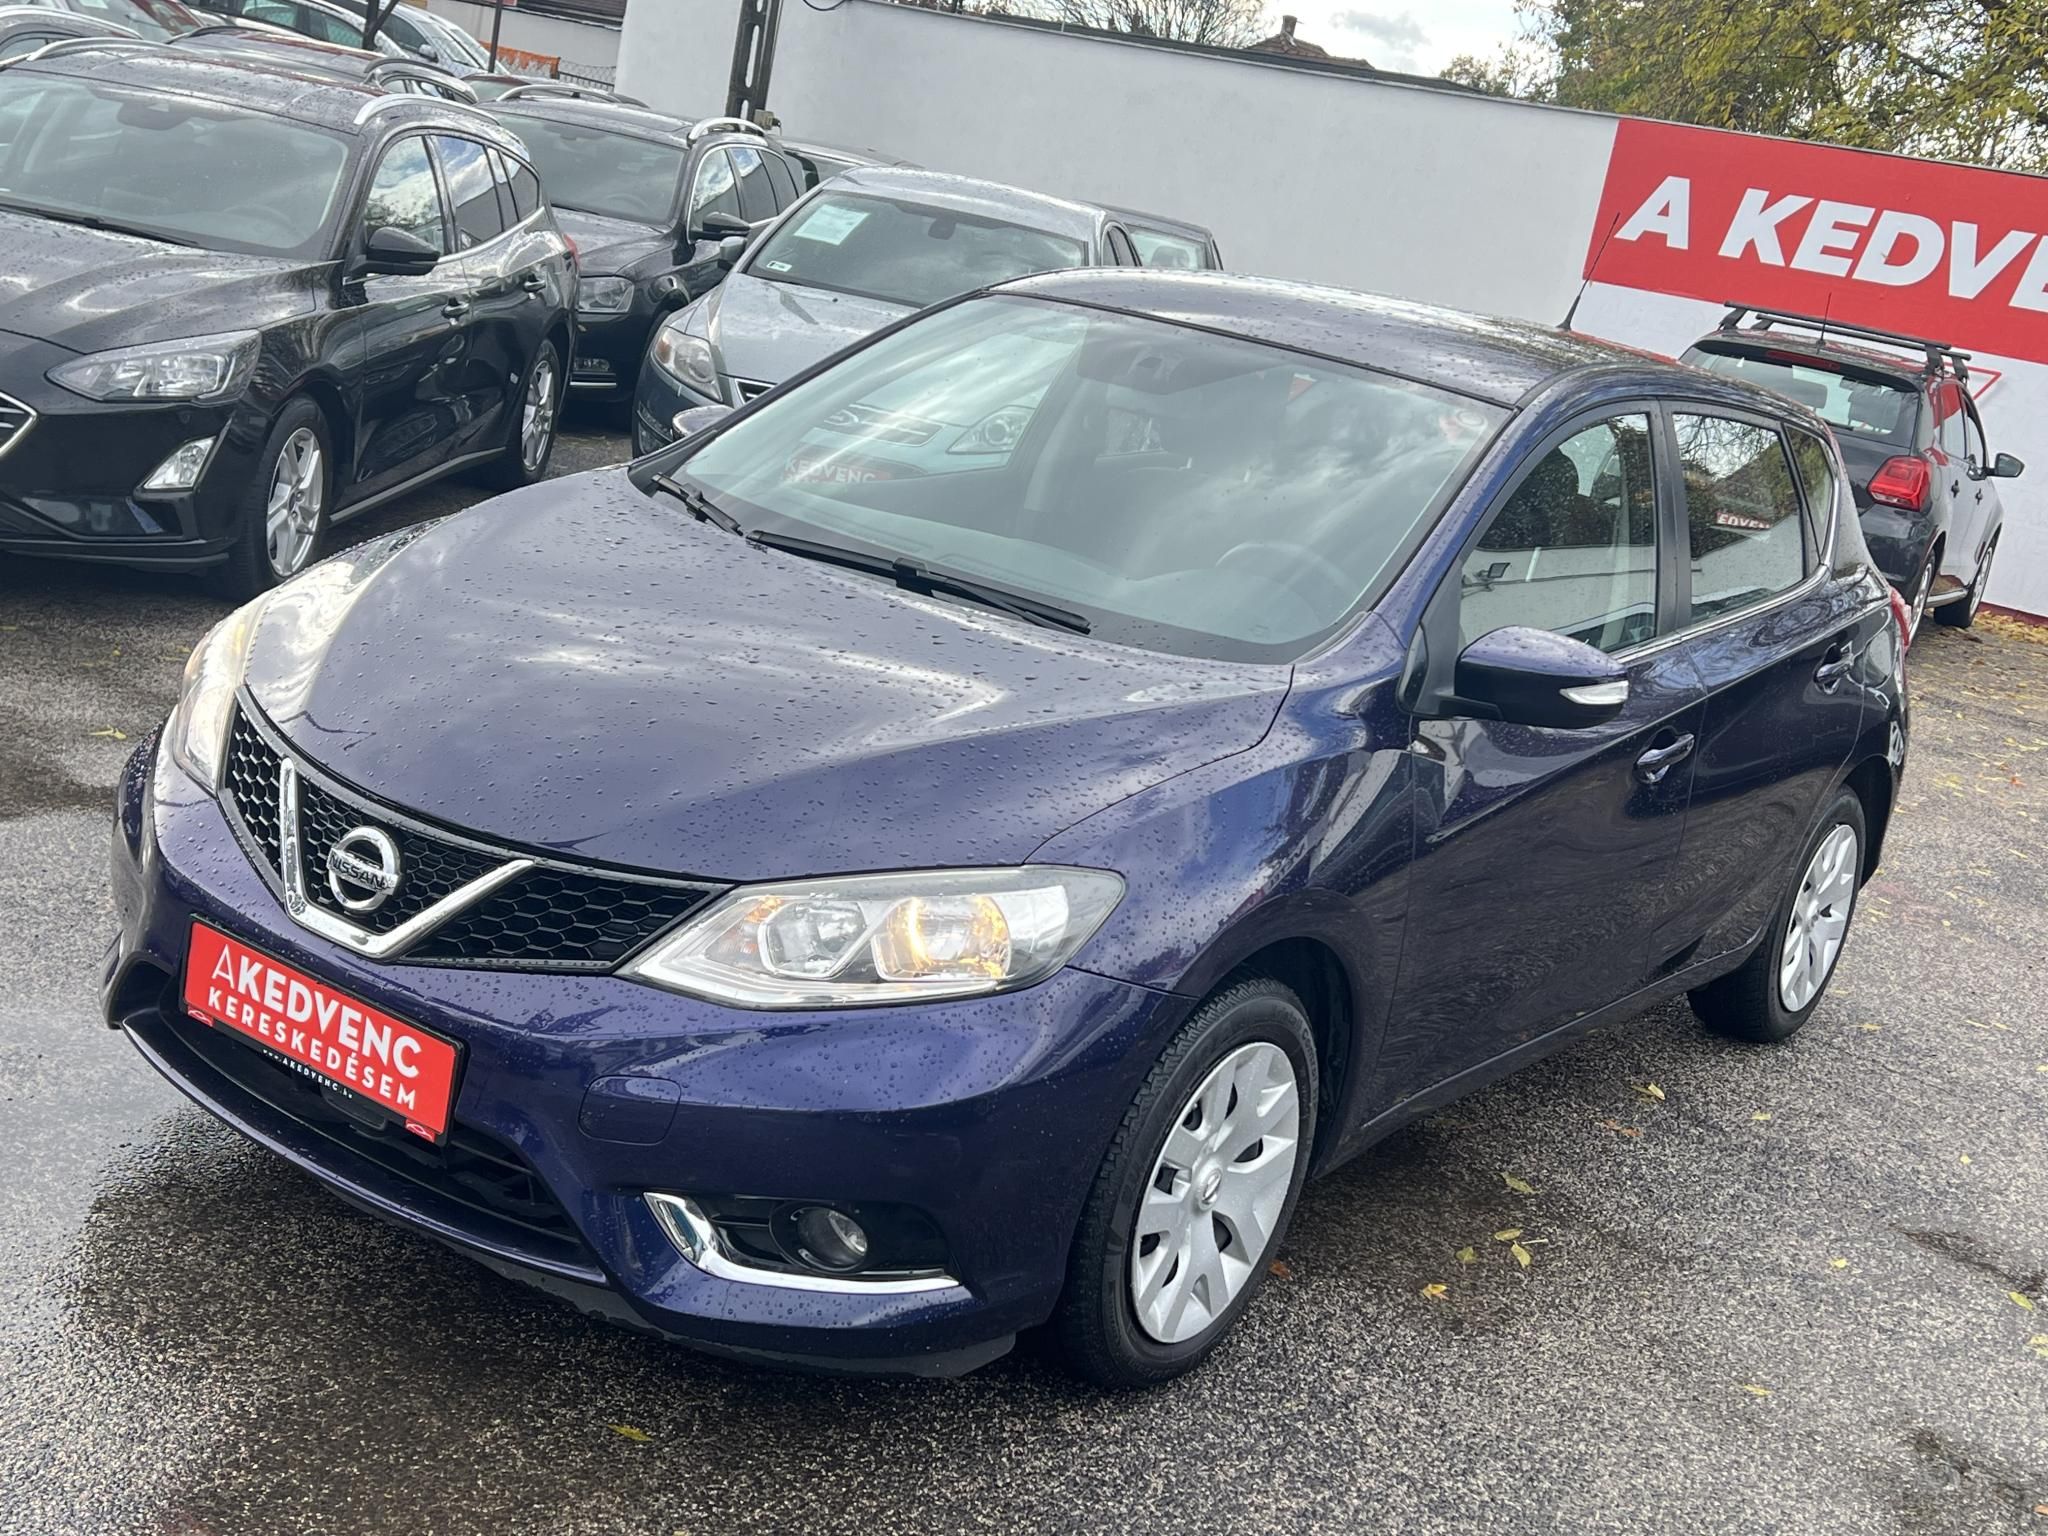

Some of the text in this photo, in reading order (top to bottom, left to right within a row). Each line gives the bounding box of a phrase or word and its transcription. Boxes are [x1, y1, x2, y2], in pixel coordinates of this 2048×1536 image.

[1614, 176, 1690, 250] A
[329, 854, 386, 888] NISSAN
[208, 986, 416, 1110] KERESKEDÉSEM
